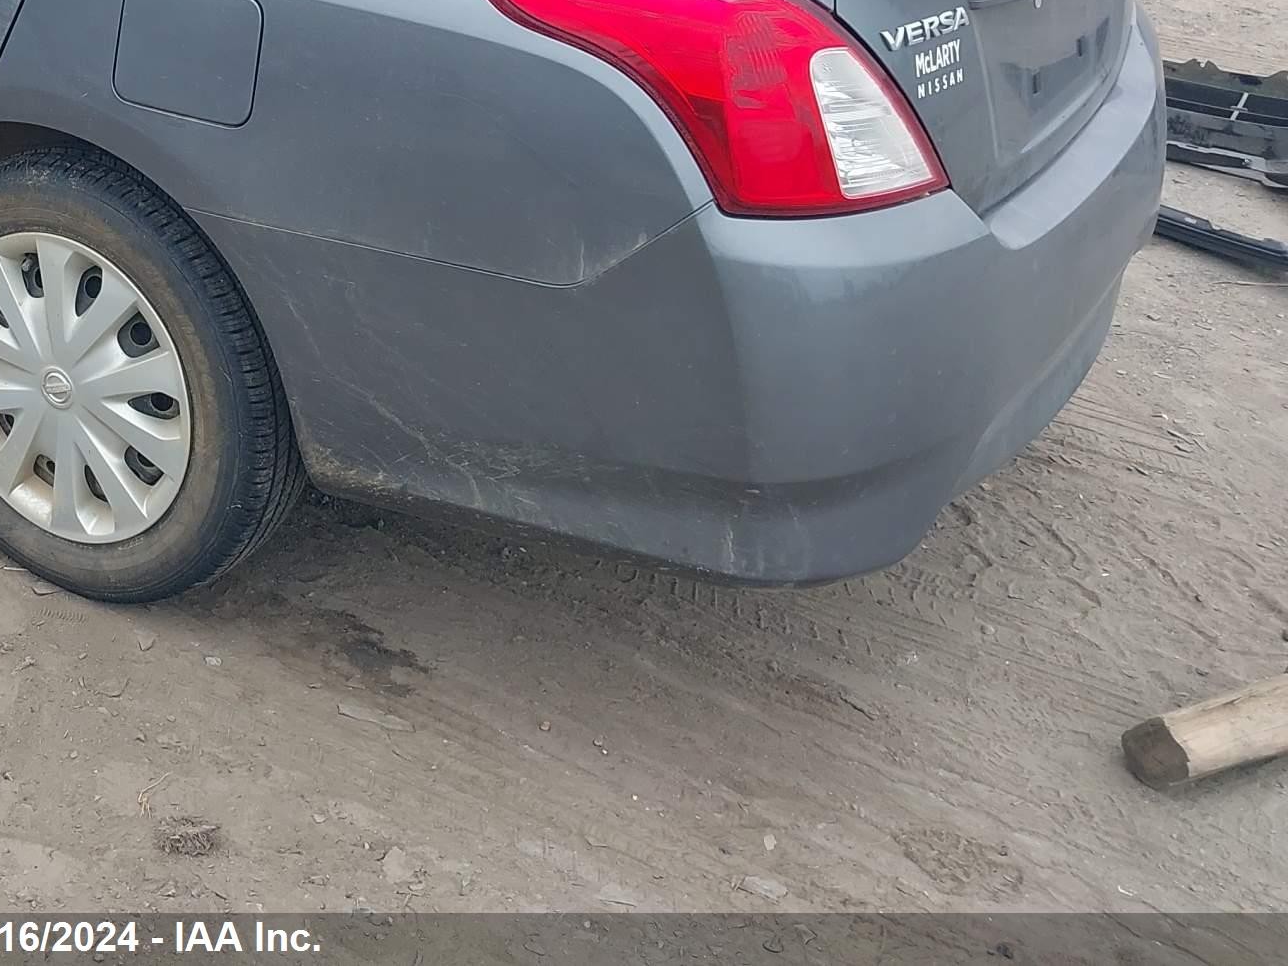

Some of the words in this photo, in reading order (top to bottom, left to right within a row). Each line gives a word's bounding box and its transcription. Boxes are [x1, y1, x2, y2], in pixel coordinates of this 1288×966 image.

[880, 6, 970, 51] VERSA
[915, 39, 961, 78] McLARTY
[917, 68, 964, 99] NISSAN
